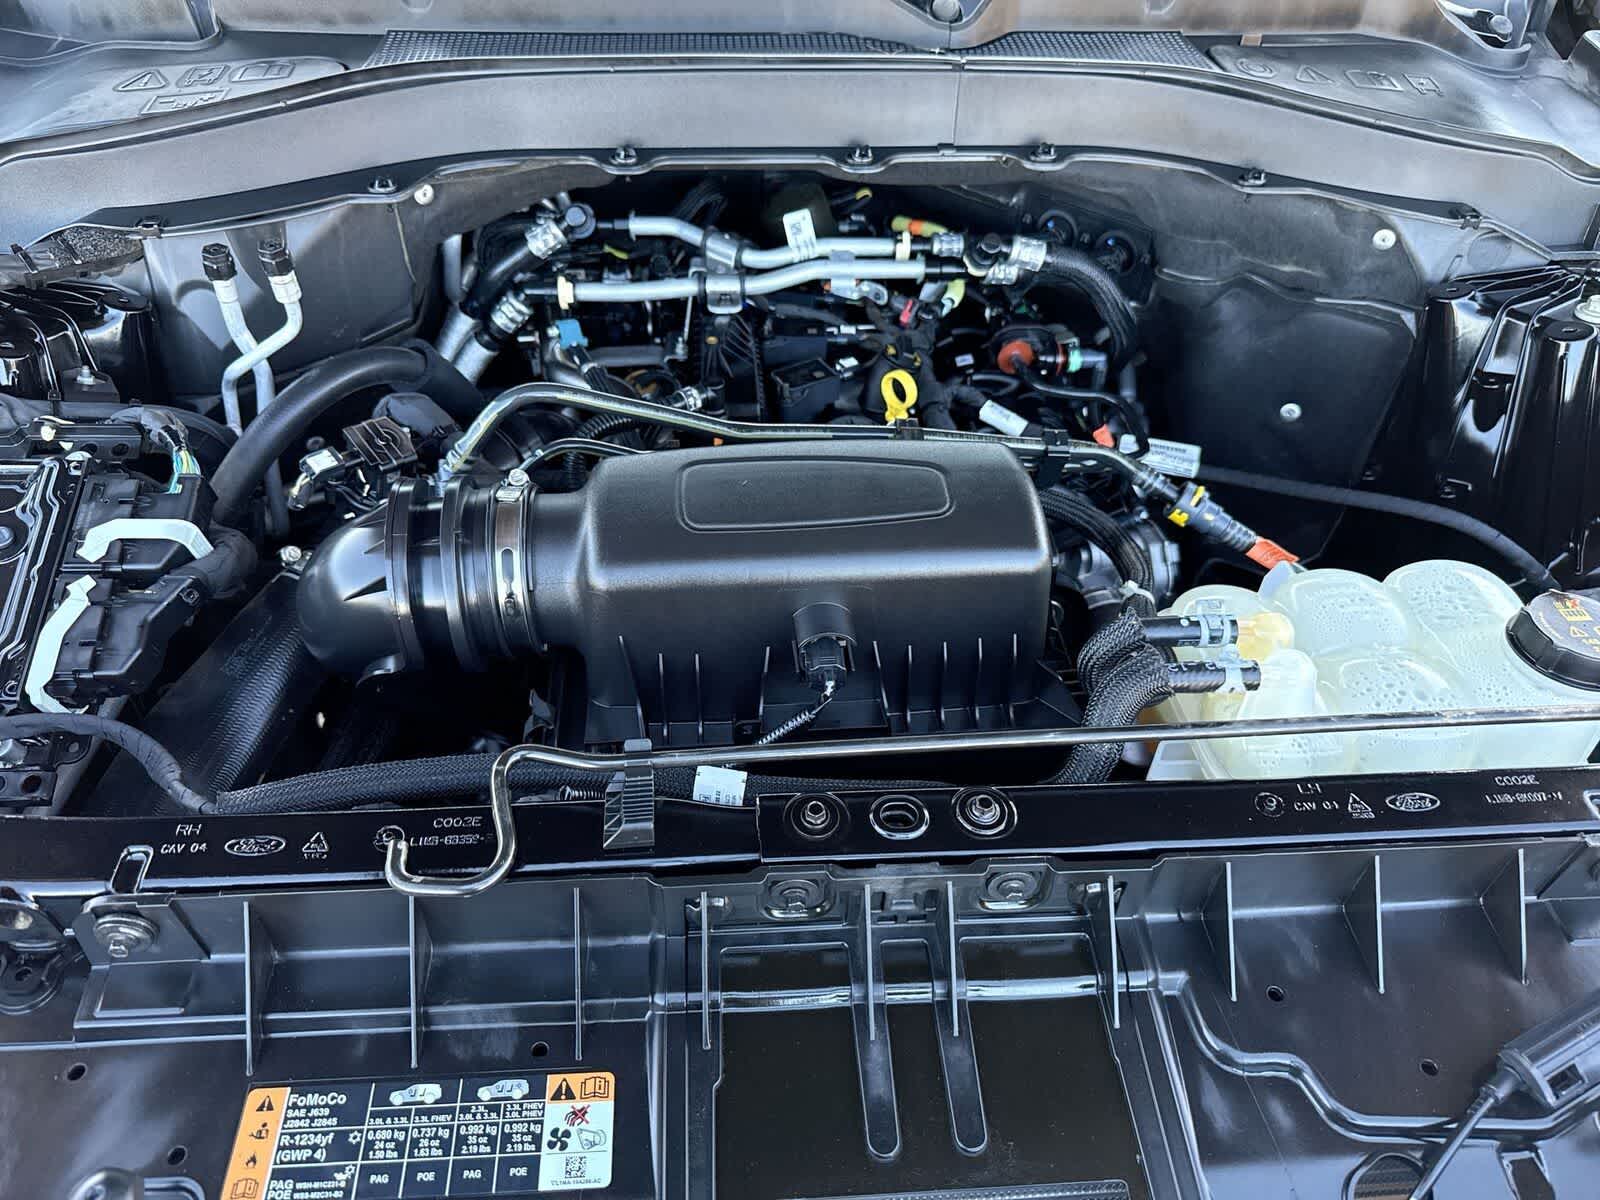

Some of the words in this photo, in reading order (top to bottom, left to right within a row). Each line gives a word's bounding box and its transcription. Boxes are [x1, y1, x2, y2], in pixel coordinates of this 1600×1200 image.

[176, 824, 201, 836] RH
[190, 842, 208, 853] 04
[288, 1092, 347, 1107] FoMoCo
[286, 1109, 307, 1118] SAE
[307, 1108, 330, 1117] J639
[283, 1119, 310, 1128] J2842
[311, 1118, 338, 1127] J2845
[504, 1123, 528, 1133] 0.992
[529, 1122, 541, 1133] kg
[367, 1130, 392, 1140] 0.680
[393, 1129, 406, 1141] kg
[412, 1127, 436, 1138] 0.737
[437, 1127, 450, 1138] kg
[460, 1124, 484, 1135] 0.992
[485, 1124, 498, 1136] kg
[279, 1132, 335, 1147] R-1234yf
[467, 1135, 477, 1144] 35
[478, 1136, 488, 1144] oz
[511, 1133, 522, 1142] 35
[522, 1134, 533, 1142] oz
[373, 1141, 384, 1149] 24
[418, 1139, 429, 1147] 26
[430, 1139, 440, 1147] oz
[505, 1143, 522, 1152] 2.19
[523, 1142, 536, 1151] lbs
[413, 1148, 429, 1157] 1.63
[430, 1147, 443, 1156] lbs
[461, 1145, 478, 1154] 2.19
[478, 1144, 491, 1153] lbs
[276, 1149, 312, 1164] (GWP
[313, 1148, 327, 1161] 4)
[368, 1151, 384, 1159] 1.50
[385, 1150, 398, 1158] lbs
[416, 1171, 436, 1181] POE
[463, 1169, 482, 1179] PAG
[509, 1167, 528, 1176] POE
[369, 1174, 389, 1184] PAG
[269, 1180, 294, 1190] PAG
[267, 1190, 292, 1200] POE
